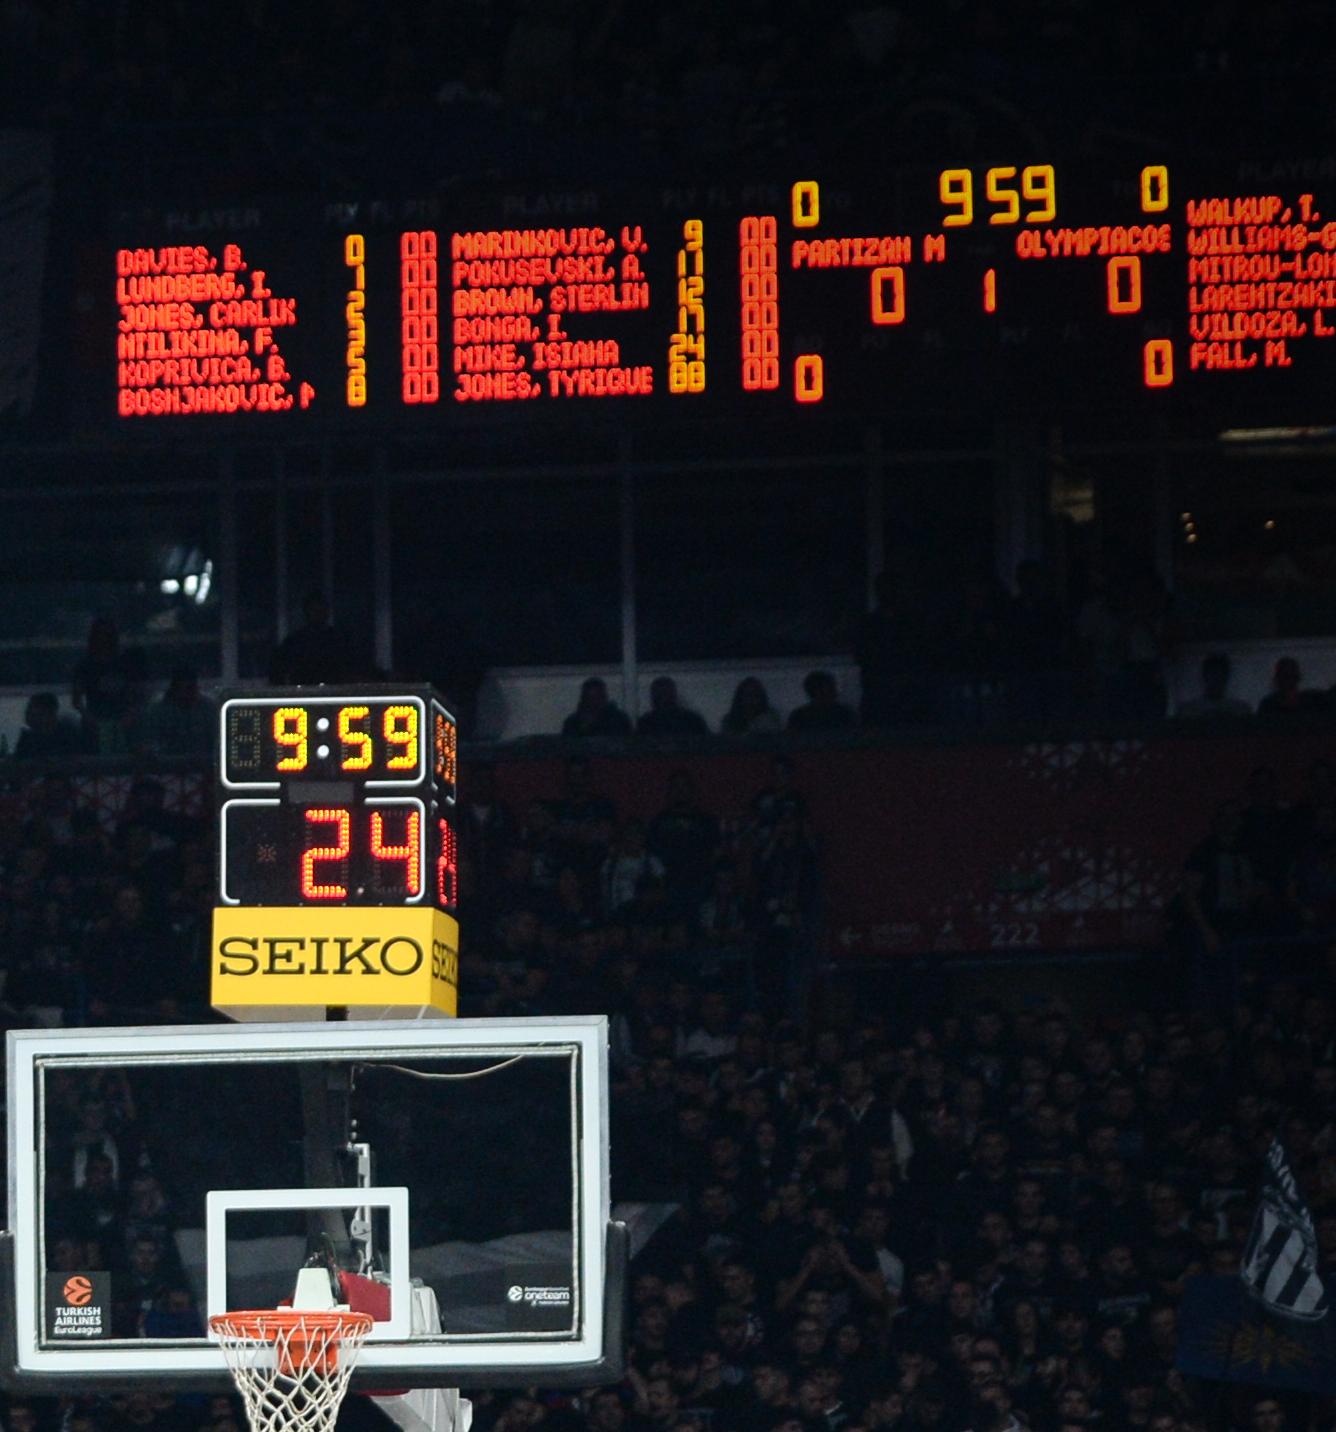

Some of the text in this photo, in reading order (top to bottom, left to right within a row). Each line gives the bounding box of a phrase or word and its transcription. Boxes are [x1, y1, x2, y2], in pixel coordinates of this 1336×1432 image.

[793, 181, 819, 227] 0
[1141, 165, 1168, 212] 0
[1187, 194, 1320, 227] WALKUP, T.
[117, 246, 216, 275] DAVIES,
[224, 244, 247, 272] B.
[452, 227, 615, 260] MARINKOVIC,
[621, 226, 648, 253] V.
[793, 234, 945, 268] PARTIZAN M
[117, 272, 245, 305] LUNDBERG,
[251, 270, 271, 299] I.
[453, 255, 615, 287] POKUSEVSKI,
[622, 254, 645, 282] A.
[1107, 256, 1141, 314] 0
[453, 286, 543, 317] BROWN,
[871, 266, 905, 324] 0
[984, 268, 996, 313] 1
[118, 302, 203, 332] JONES,
[454, 315, 540, 344] BONGA,
[548, 313, 567, 341] I.
[1190, 310, 1307, 341] VILDOZA,
[1315, 308, 1335, 336] L.
[255, 326, 279, 355] F.
[1190, 339, 1292, 370] FALL, M.
[119, 356, 261, 387] KOPRIVICA,
[267, 355, 291, 382] B.
[454, 344, 525, 373] MIKE,
[1144, 339, 1173, 387] 0
[455, 371, 540, 402] JONES,
[549, 366, 653, 397] TYRIQUE
[795, 353, 823, 402] 0
[274, 706, 418, 770] 9:59
[302, 809, 419, 898] 24
[219, 936, 423, 976] SEIKO
[55, 1307, 101, 1316] TURKISH
[55, 1316, 102, 1326] AIRLINES
